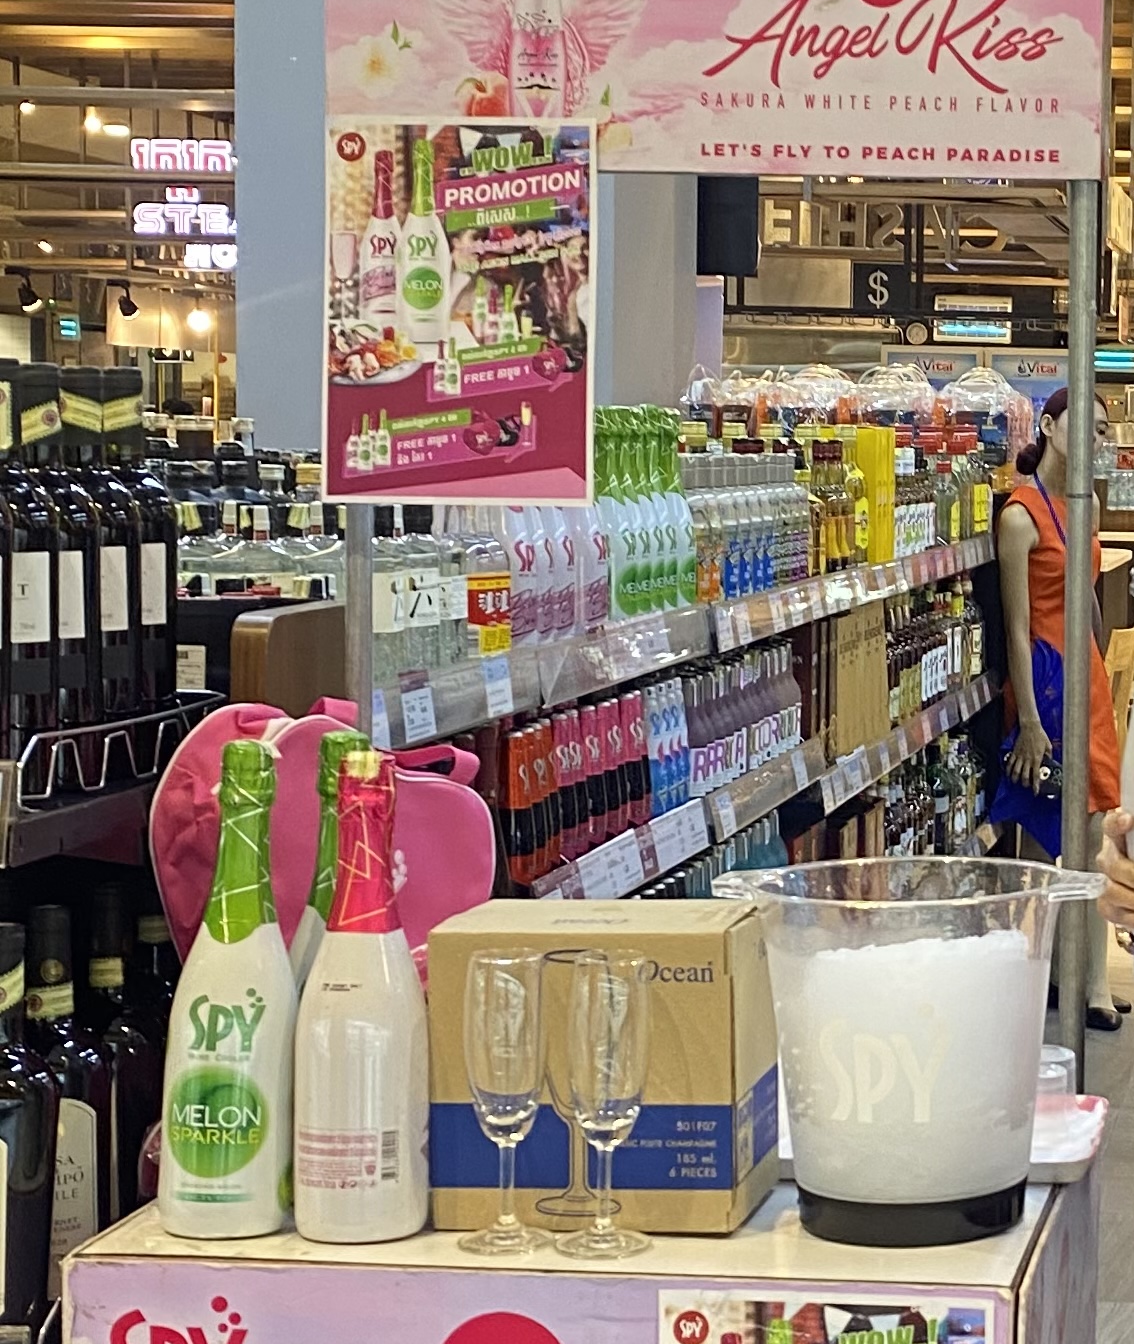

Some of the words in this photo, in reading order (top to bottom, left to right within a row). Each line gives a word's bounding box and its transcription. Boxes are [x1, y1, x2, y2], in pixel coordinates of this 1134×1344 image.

[700, 92, 786, 110] SAKURA
[804, 94, 871, 111] WHITE
[889, 96, 958, 112] PEACH
[976, 98, 1060, 114] FLAVOR
[700, 143, 762, 158] LET'S
[773, 144, 812, 158] FLY
[824, 146, 850, 159] TO
[862, 147, 936, 162] PEACH
[947, 148, 1060, 163] PARADISE
[444, 170, 581, 208] PROMOTION
[133, 202, 238, 235] STE
[370, 231, 396, 256] SPY
[408, 230, 438, 257] SPY
[867, 269, 890, 309] $
[464, 370, 495, 384] FREE
[923, 358, 954, 374] Vital
[1027, 360, 1058, 376] Vital
[397, 437, 425, 451] FREE
[189, 988, 267, 1052] SPY
[816, 1002, 949, 1123] SPY
[172, 1104, 262, 1128] MELON
[171, 1126, 261, 1145] SPARKLE
[681, 1167, 718, 1178] PIECES
[680, 1316, 702, 1339] SPY
